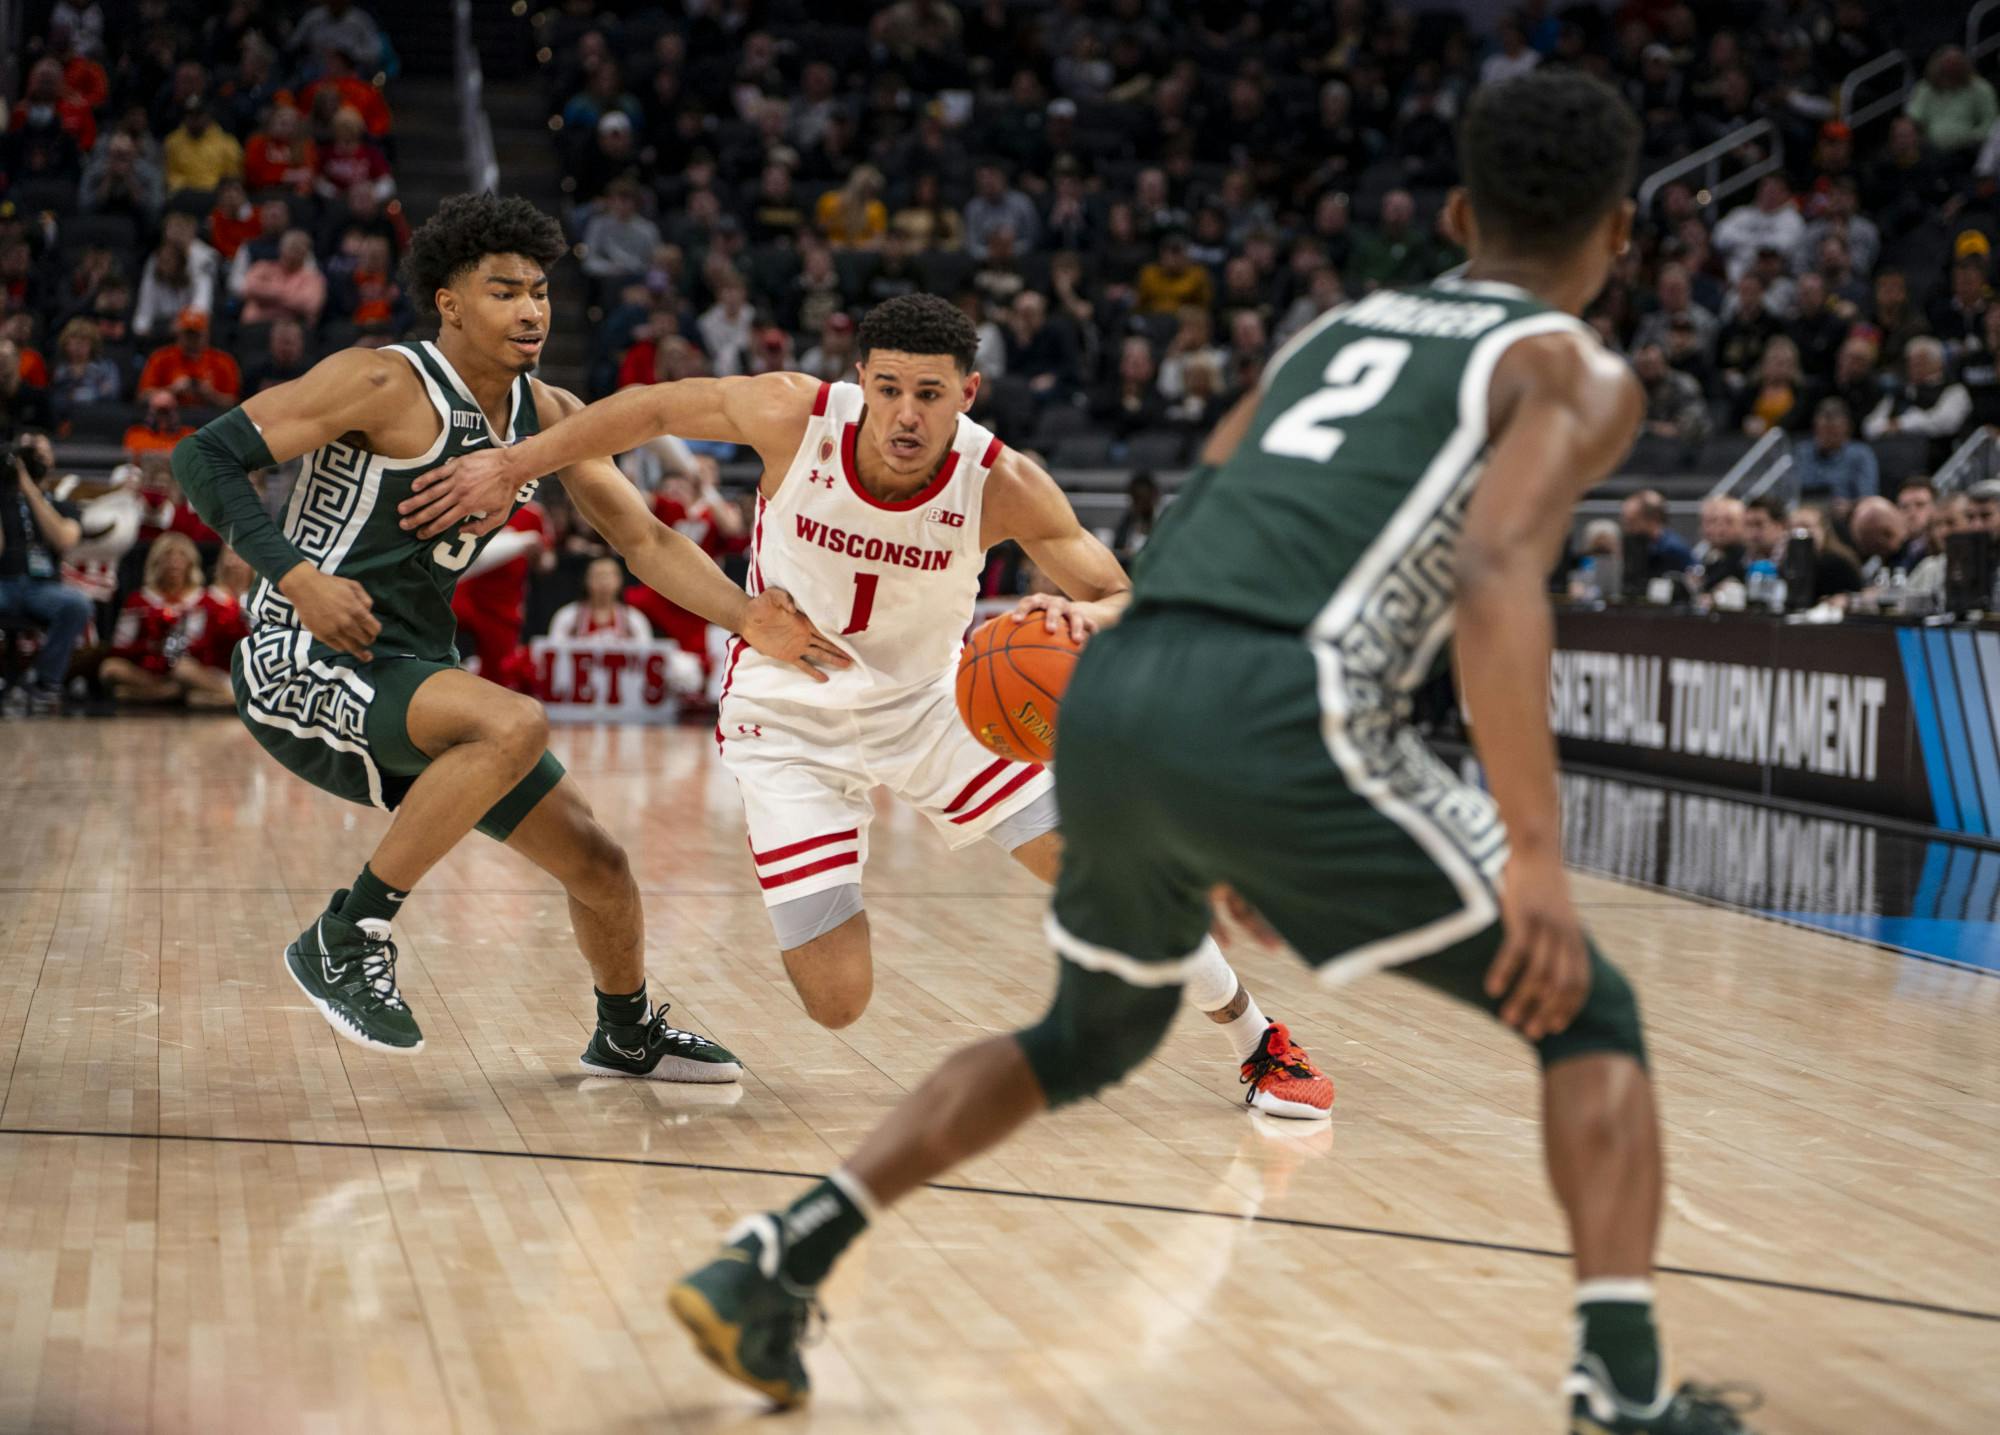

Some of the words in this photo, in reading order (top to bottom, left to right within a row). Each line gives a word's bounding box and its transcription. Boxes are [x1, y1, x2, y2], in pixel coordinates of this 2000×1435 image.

[452, 410, 483, 430] UNITY
[1261, 336, 1412, 463] 2
[796, 513, 952, 571] WISCONSIN
[841, 572, 879, 636] 1
[538, 648, 668, 706] LET'S
[1547, 649, 1666, 750] SKETBALL
[1669, 657, 1887, 782] TOURNAMENT
